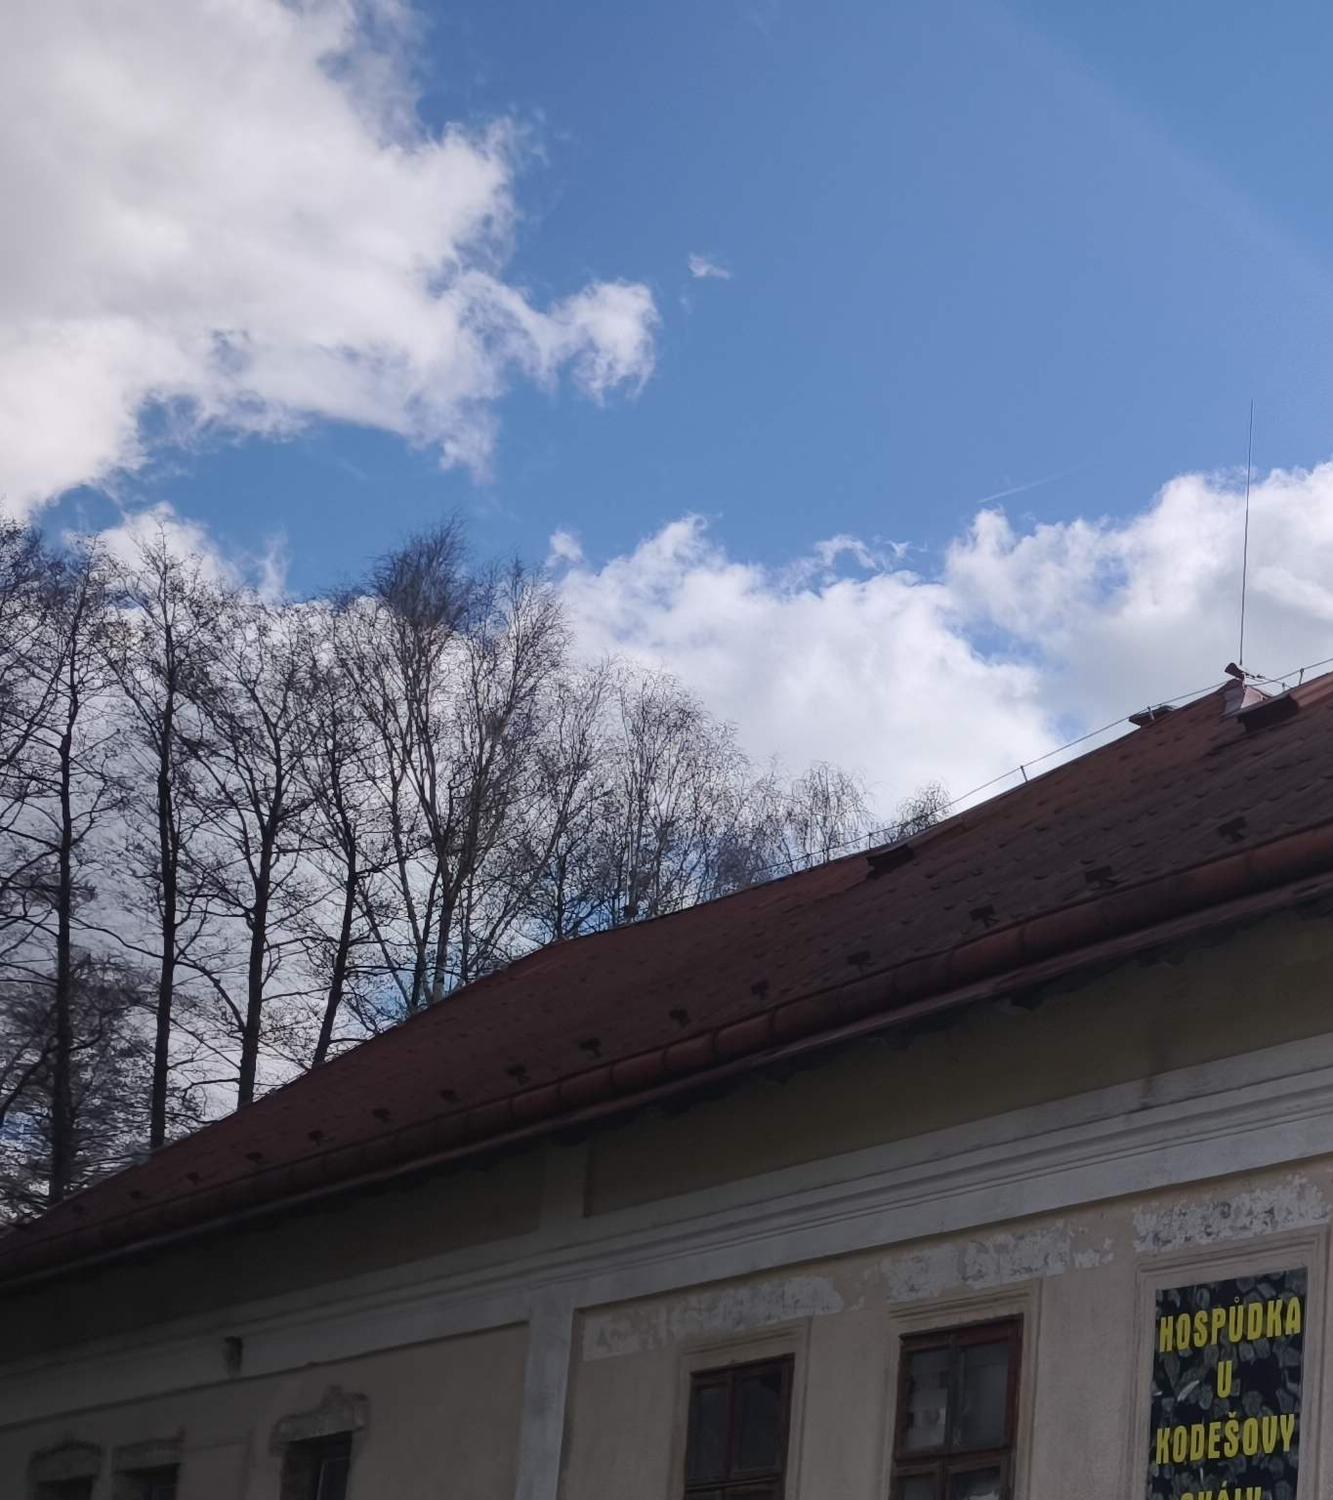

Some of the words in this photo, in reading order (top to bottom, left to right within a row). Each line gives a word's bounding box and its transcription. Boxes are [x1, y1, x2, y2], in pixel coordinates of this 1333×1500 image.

[1159, 1296, 1301, 1352] HOSPŮDKA
[1216, 1360, 1233, 1398] U
[1155, 1411, 1296, 1465] KODEŠOVY
